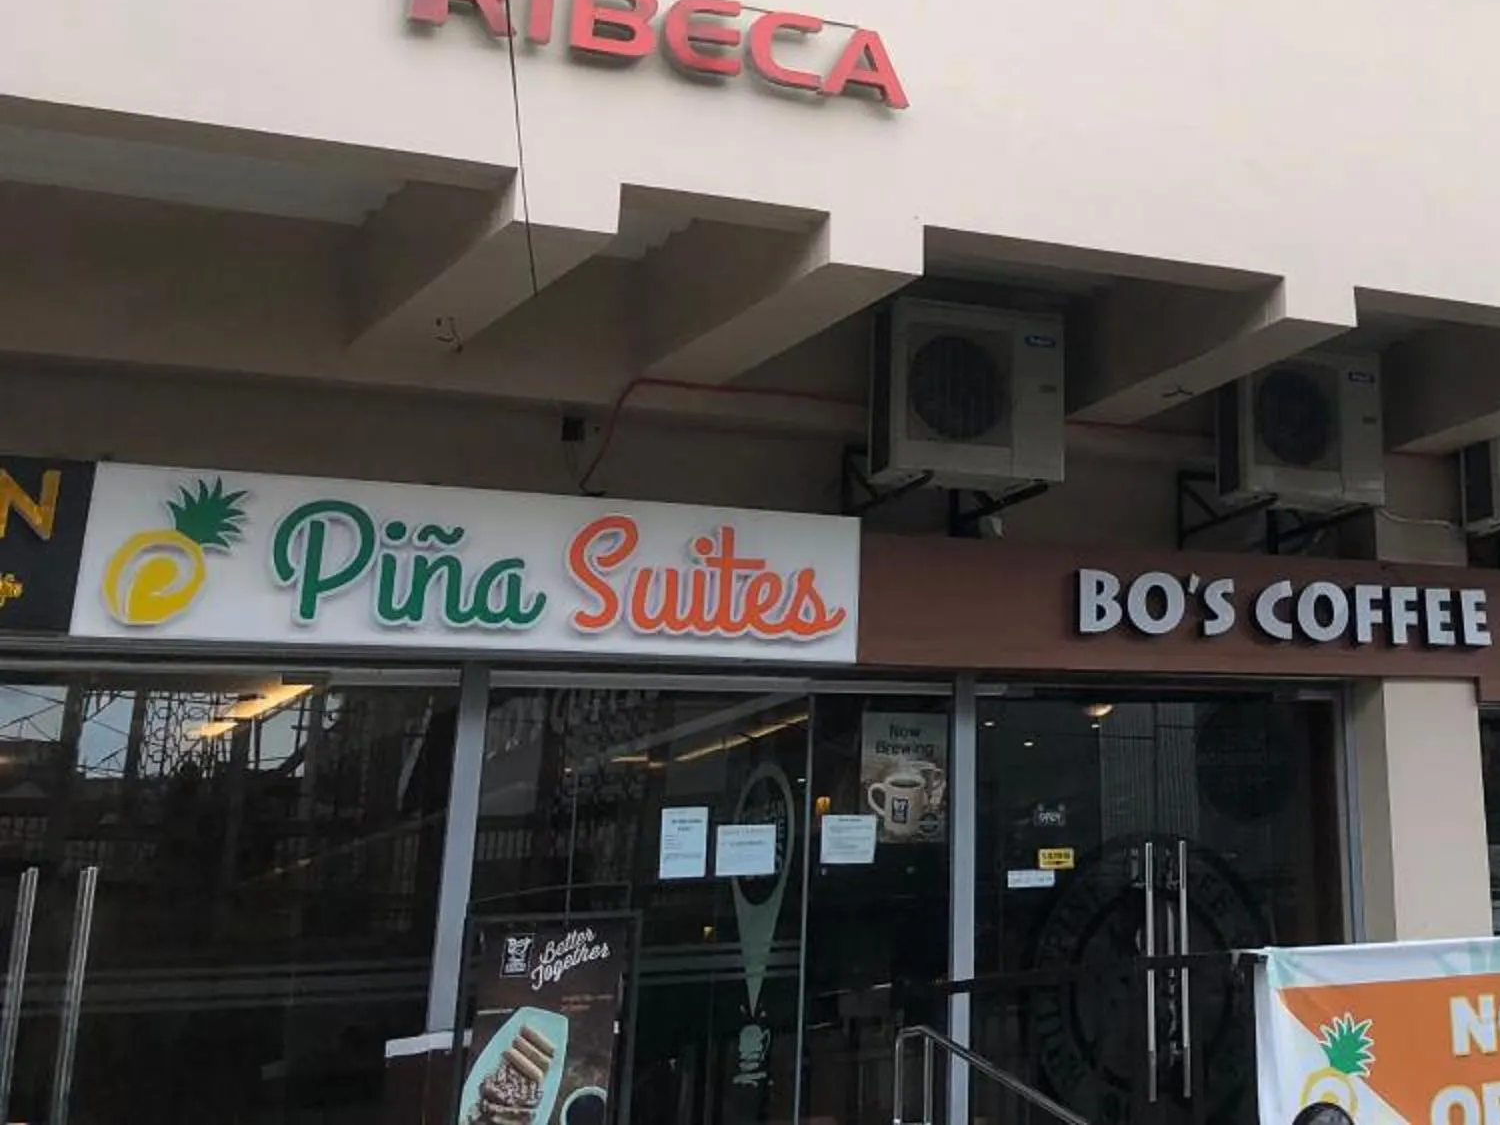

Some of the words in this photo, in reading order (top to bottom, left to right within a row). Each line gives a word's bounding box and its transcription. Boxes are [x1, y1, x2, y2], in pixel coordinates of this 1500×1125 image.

[273, 500, 545, 630] Piña
[567, 513, 845, 639] Suites
[1075, 567, 1235, 637] BO'S
[1253, 578, 1493, 647] COFFEE
[876, 741, 934, 756] Brewing
[531, 942, 611, 991] Together
[540, 927, 597, 964] Better
